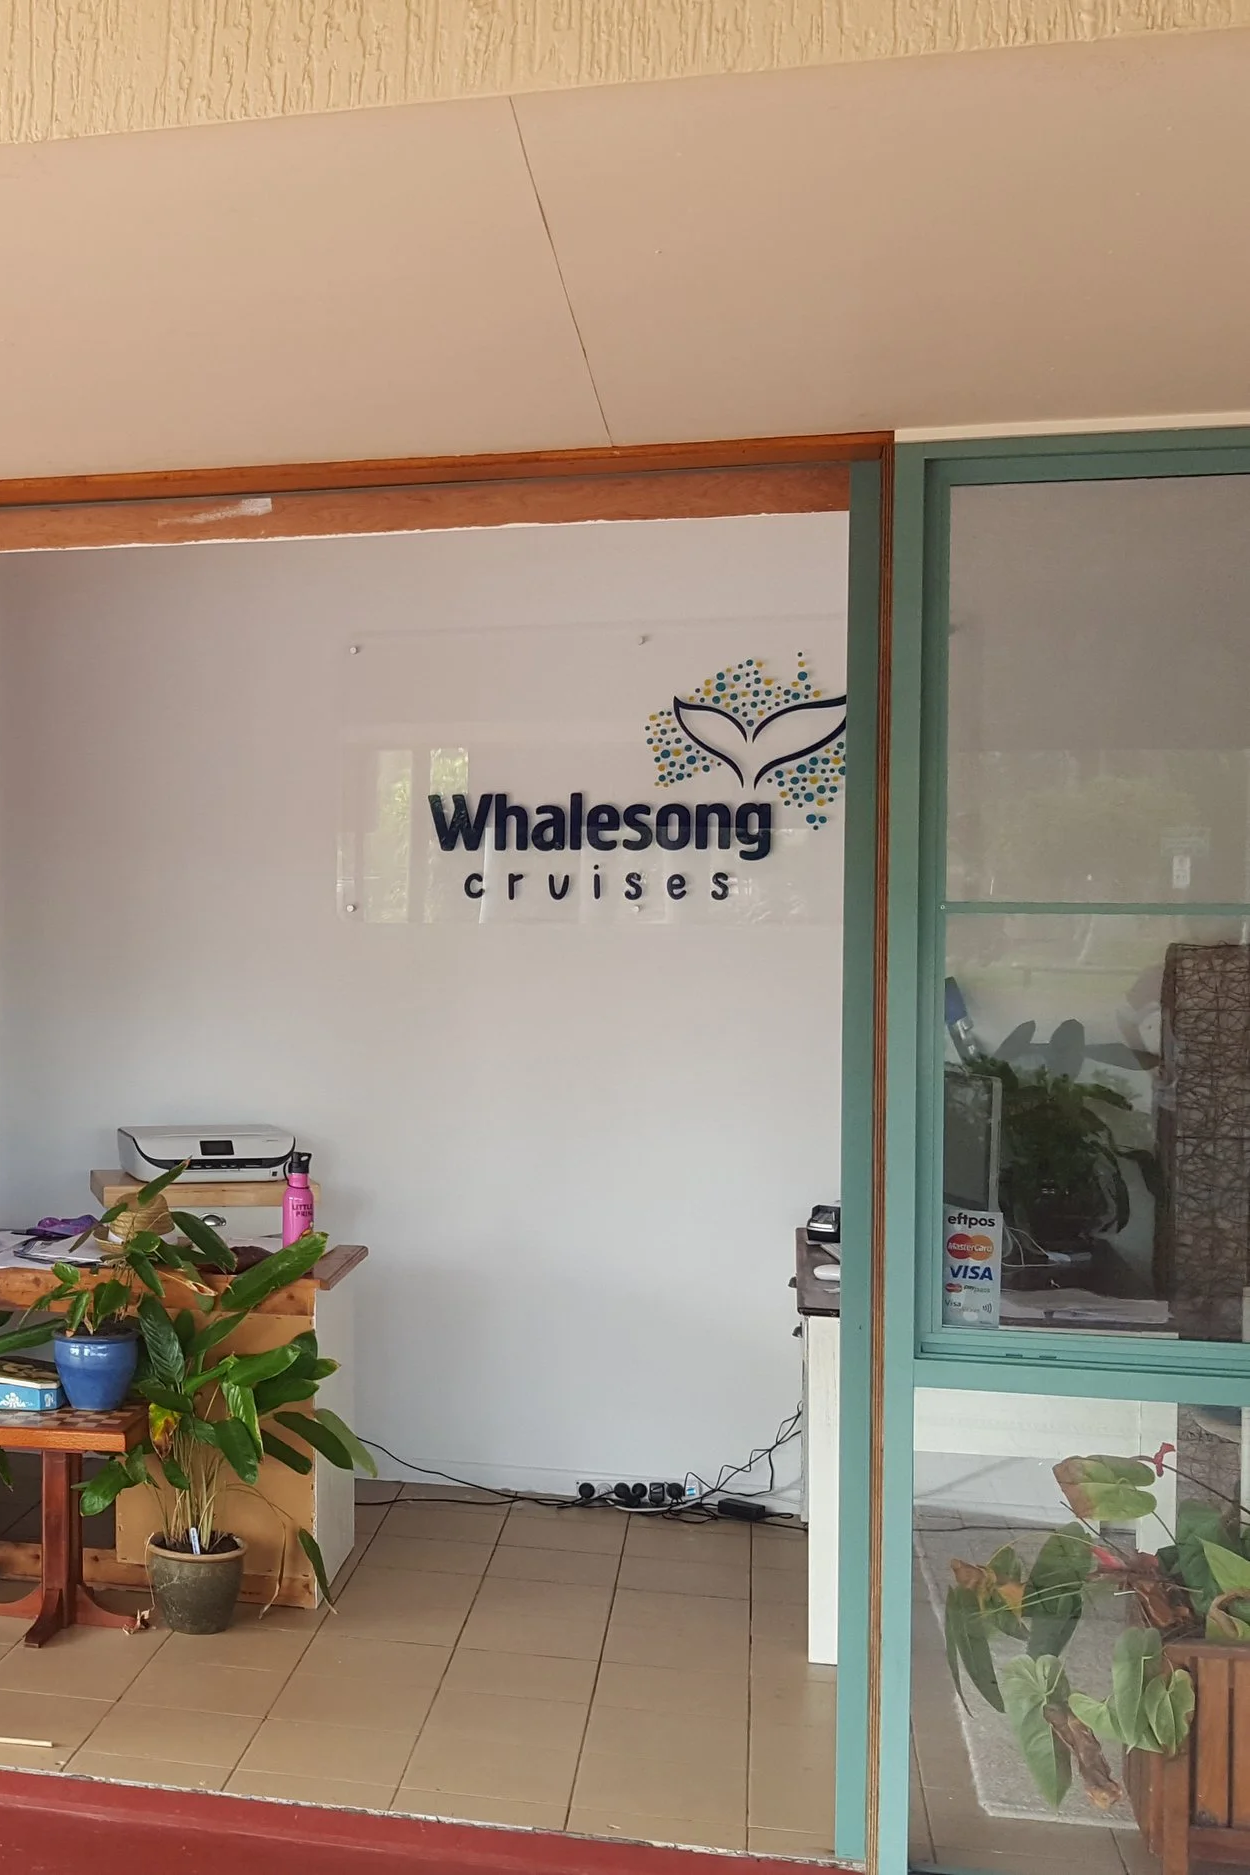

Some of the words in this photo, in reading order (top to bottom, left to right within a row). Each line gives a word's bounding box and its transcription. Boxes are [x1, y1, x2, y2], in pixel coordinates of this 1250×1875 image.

[428, 792, 772, 860] Whalesong
[463, 864, 731, 901] cruises
[947, 1212, 996, 1229] eftpos
[948, 1242, 993, 1254] MasterCard
[950, 1265, 994, 1281] VISA
